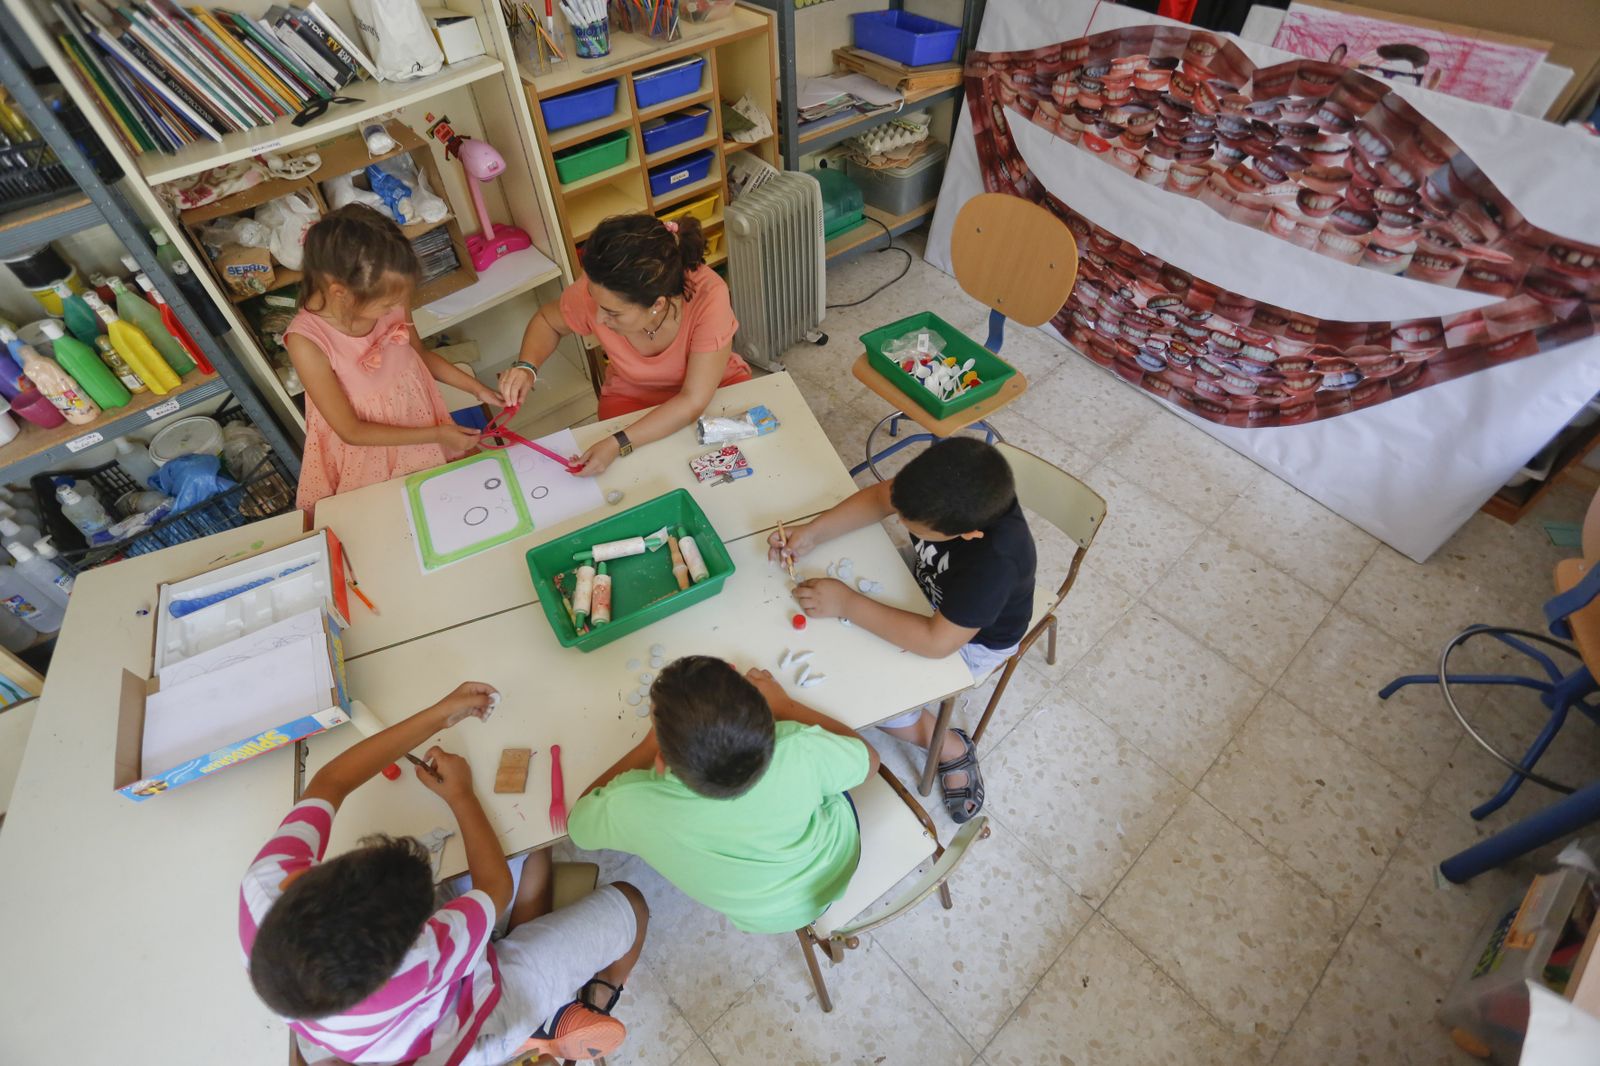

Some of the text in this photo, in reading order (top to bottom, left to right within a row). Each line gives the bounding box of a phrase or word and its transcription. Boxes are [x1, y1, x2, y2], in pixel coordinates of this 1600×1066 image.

[307, 19, 325, 38] TDK
[327, 35, 341, 51] TV
[338, 48, 352, 64] 180
